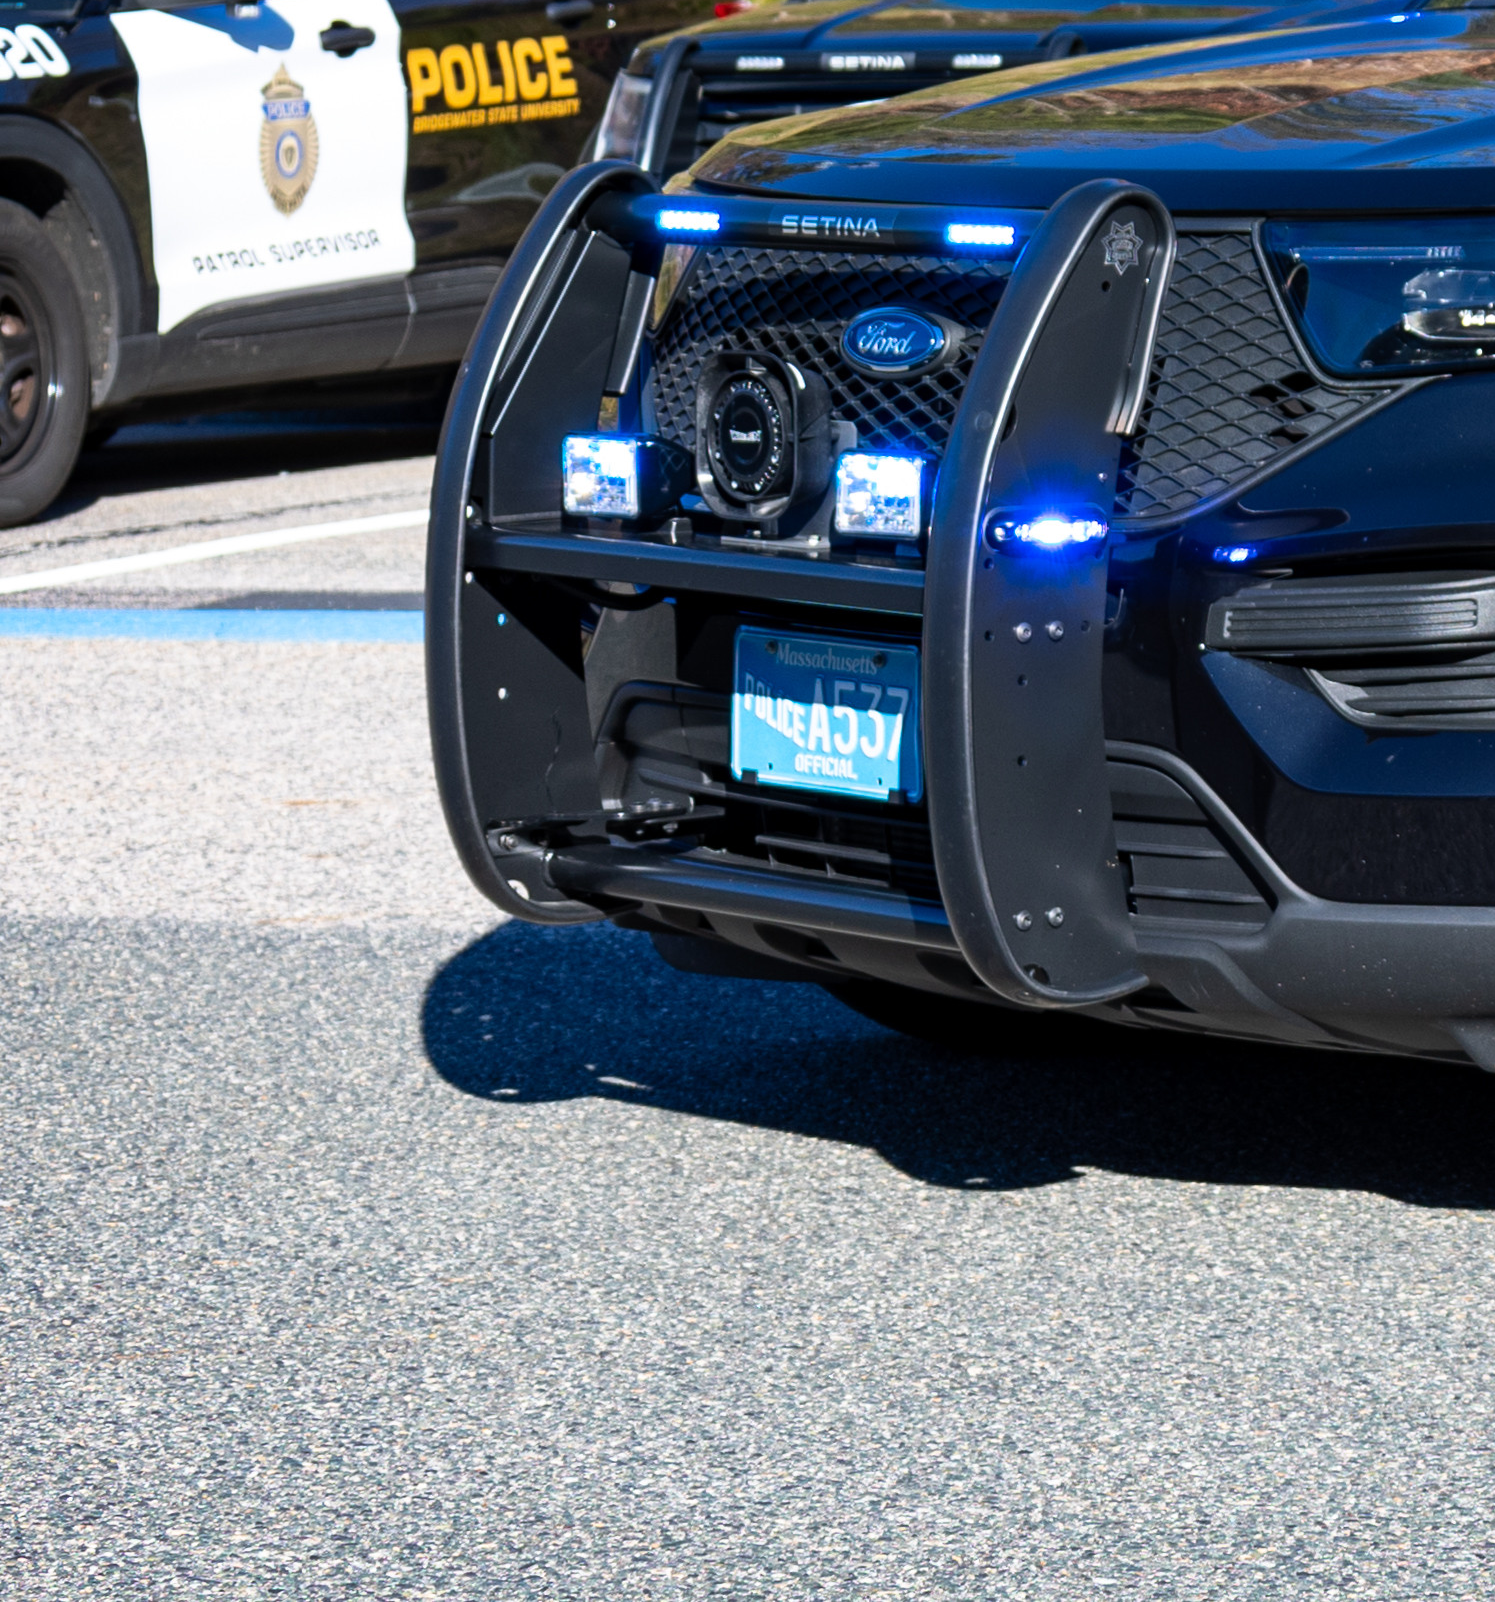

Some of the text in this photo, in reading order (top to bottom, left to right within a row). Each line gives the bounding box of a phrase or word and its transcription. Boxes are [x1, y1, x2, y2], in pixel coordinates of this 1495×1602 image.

[407, 34, 578, 114] POLICE
[828, 55, 906, 70] SETINA
[267, 100, 306, 120] POLICE
[412, 97, 581, 135] BRIDGEWATER STATE UNIVERSITY
[781, 214, 881, 238] SETINA
[192, 228, 381, 274] PATROL SUPERVISOR
[858, 320, 917, 355] Ford
[776, 643, 878, 676] Massachusetts
[744, 671, 806, 749] POLICE
[794, 753, 859, 780] OFFICIAL
